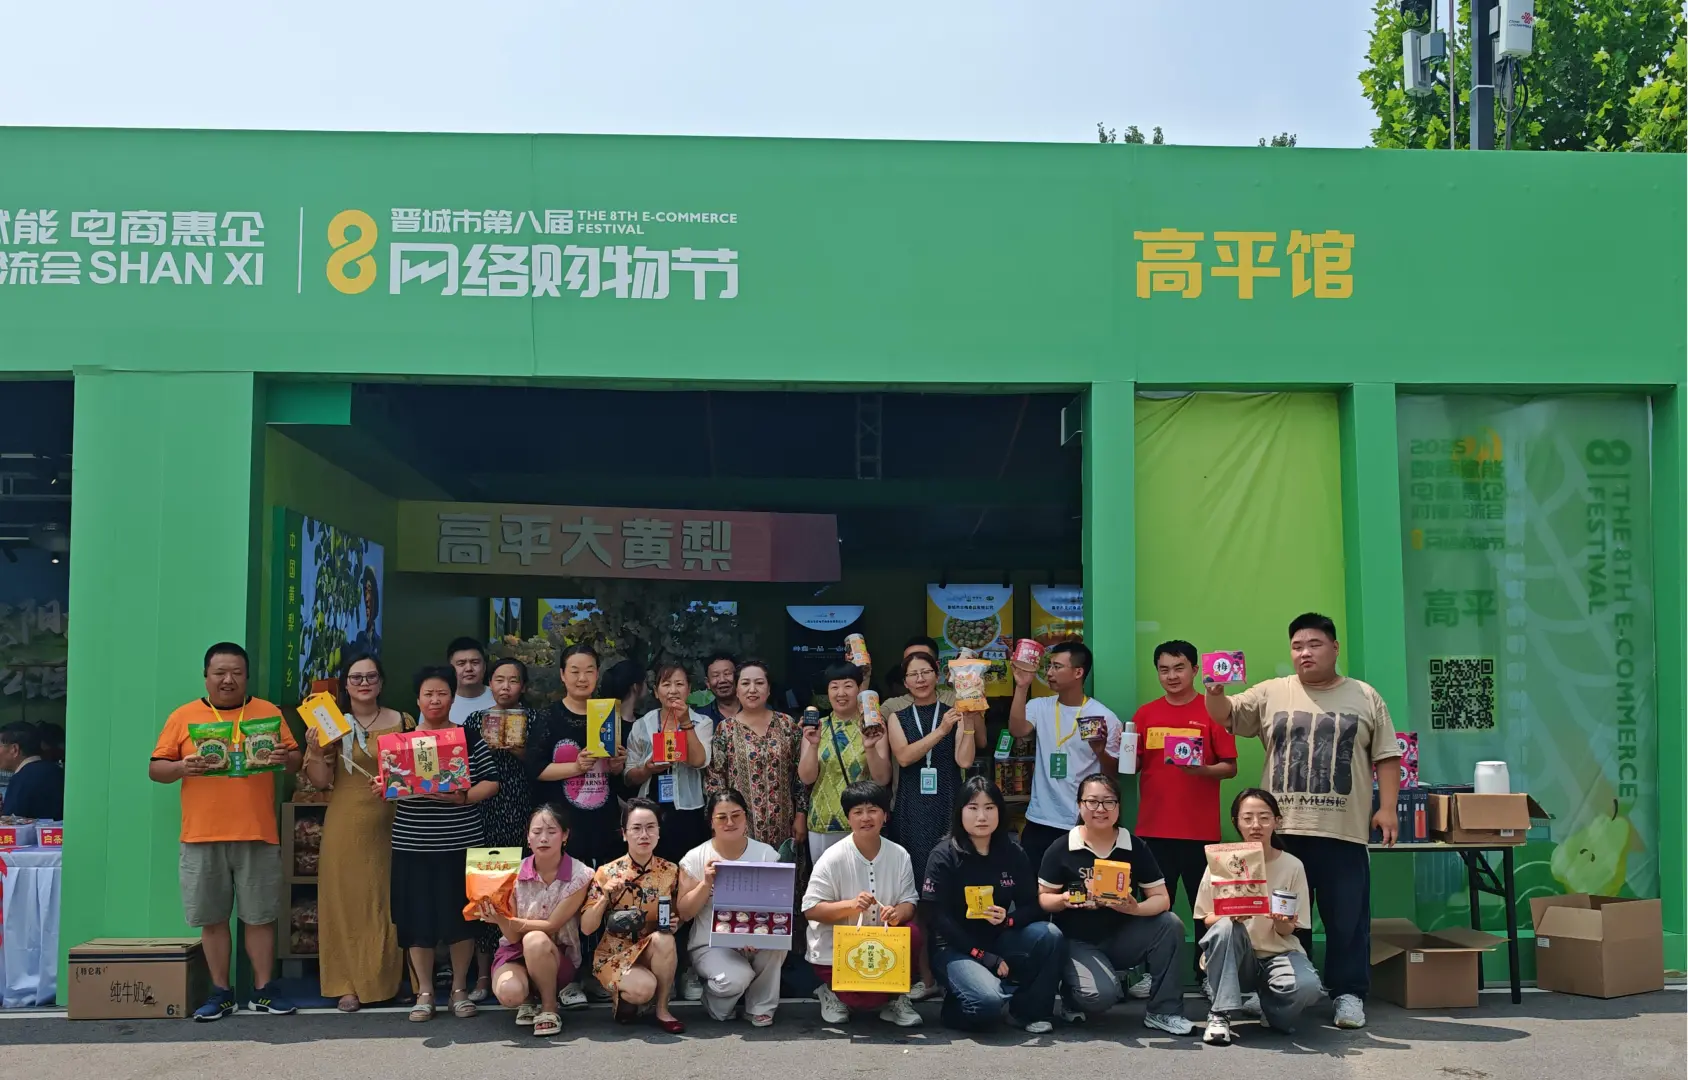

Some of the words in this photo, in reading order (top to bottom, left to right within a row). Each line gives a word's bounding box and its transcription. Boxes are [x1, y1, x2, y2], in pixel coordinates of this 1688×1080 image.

[71, 209, 265, 248] 电商惠企
[390, 207, 574, 235] 晋城市第八届
[577, 210, 606, 221] THE
[609, 211, 639, 222] 8TH
[642, 211, 738, 225] E-COMMERCE
[577, 223, 645, 236] FESTIVAL
[89, 251, 214, 285] SHAN
[222, 252, 264, 286] XI
[388, 242, 740, 301] 网络购物节
[1133, 228, 1356, 300] 高平馆
[1612, 484, 1632, 545] THE
[437, 512, 733, 573] 高平大黄梨
[1585, 486, 1608, 616] FESTIVAL
[1612, 549, 1633, 603] 8TH
[285, 531, 297, 688] 中国黄梨之乡
[1423, 588, 1498, 628] 高平
[1216, 661, 1228, 672] 梅
[1613, 612, 1639, 799] E-COMMERCE
[1178, 745, 1189, 756] 梅
[1299, 795, 1348, 808] MUSIC
[80, 966, 102, 976] 特仑苏
[110, 980, 145, 1004] 纯牛奶
[166, 1004, 176, 1016] 6
